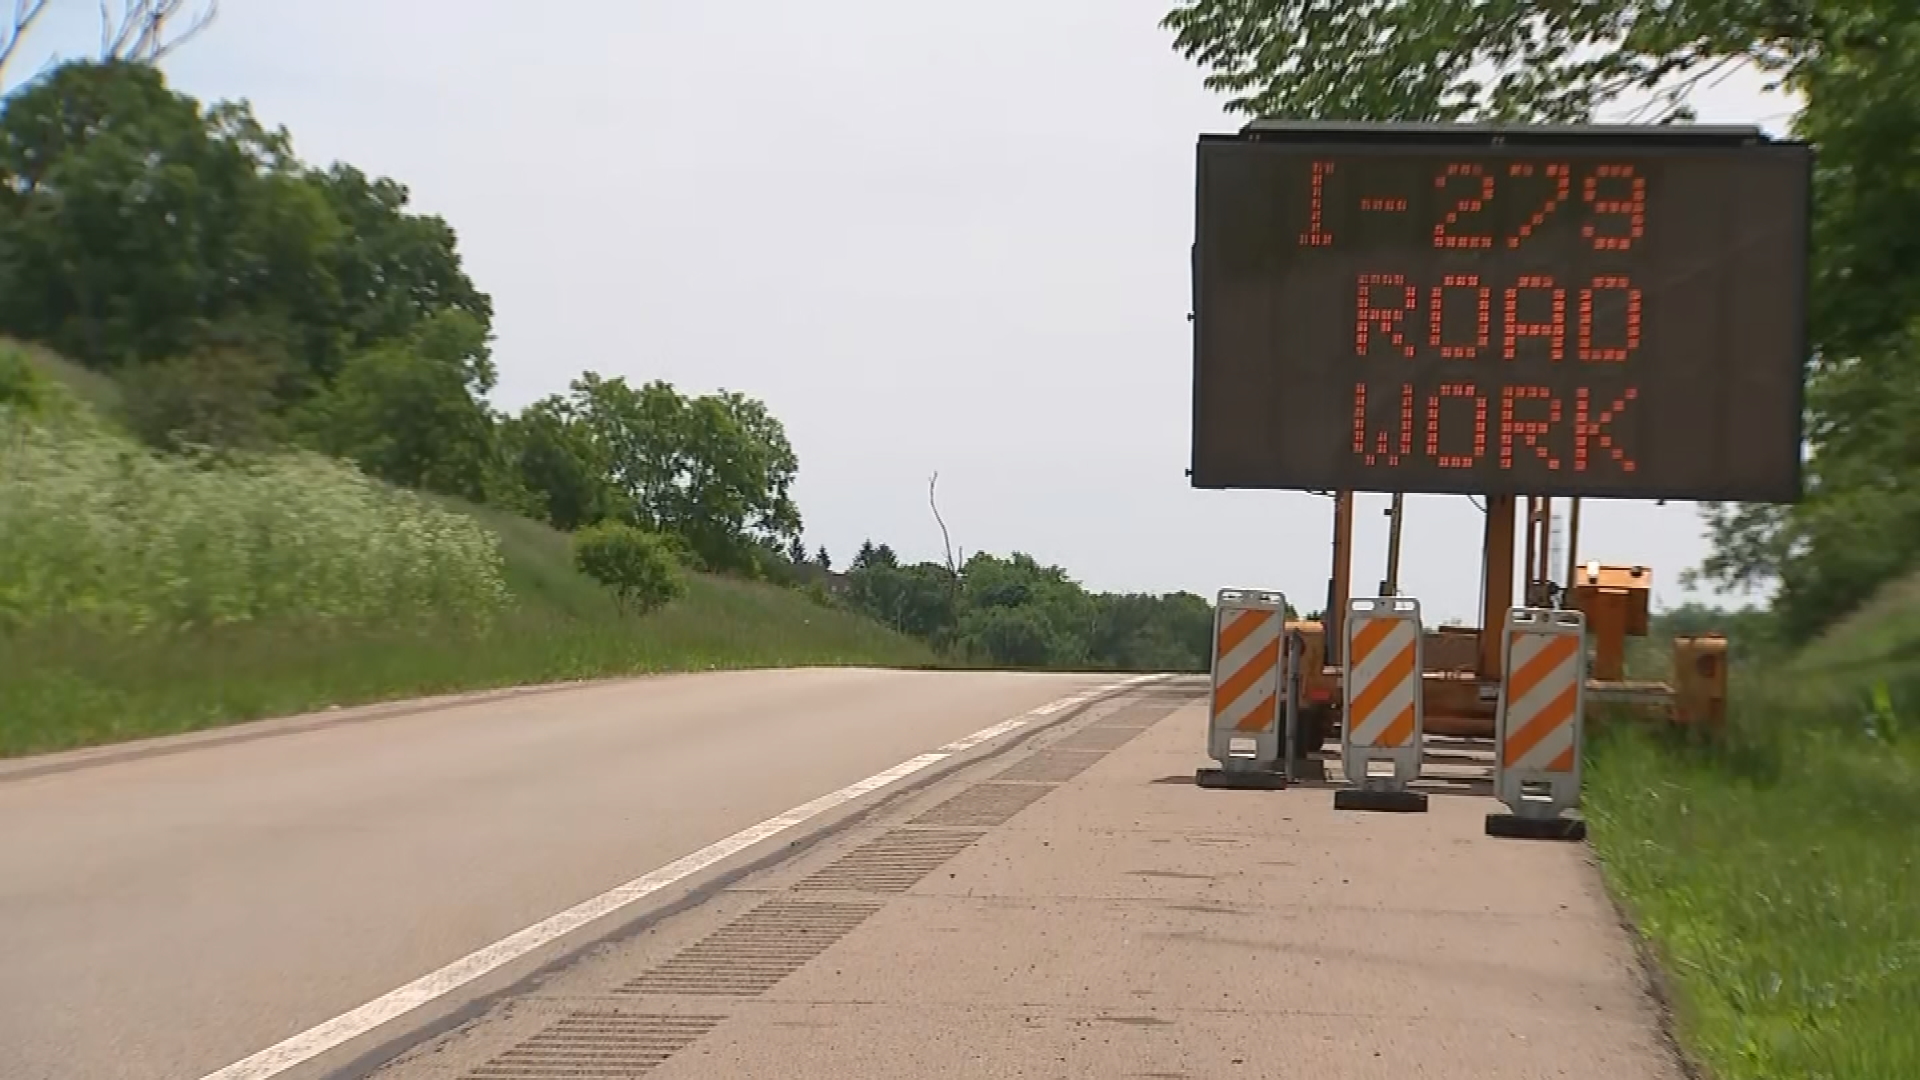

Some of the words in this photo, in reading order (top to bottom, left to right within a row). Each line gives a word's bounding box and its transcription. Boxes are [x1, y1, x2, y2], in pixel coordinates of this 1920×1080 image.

[1299, 161, 1645, 250] I-279
[1356, 274, 1642, 361] ROAD
[1353, 382, 1638, 471] WORK
